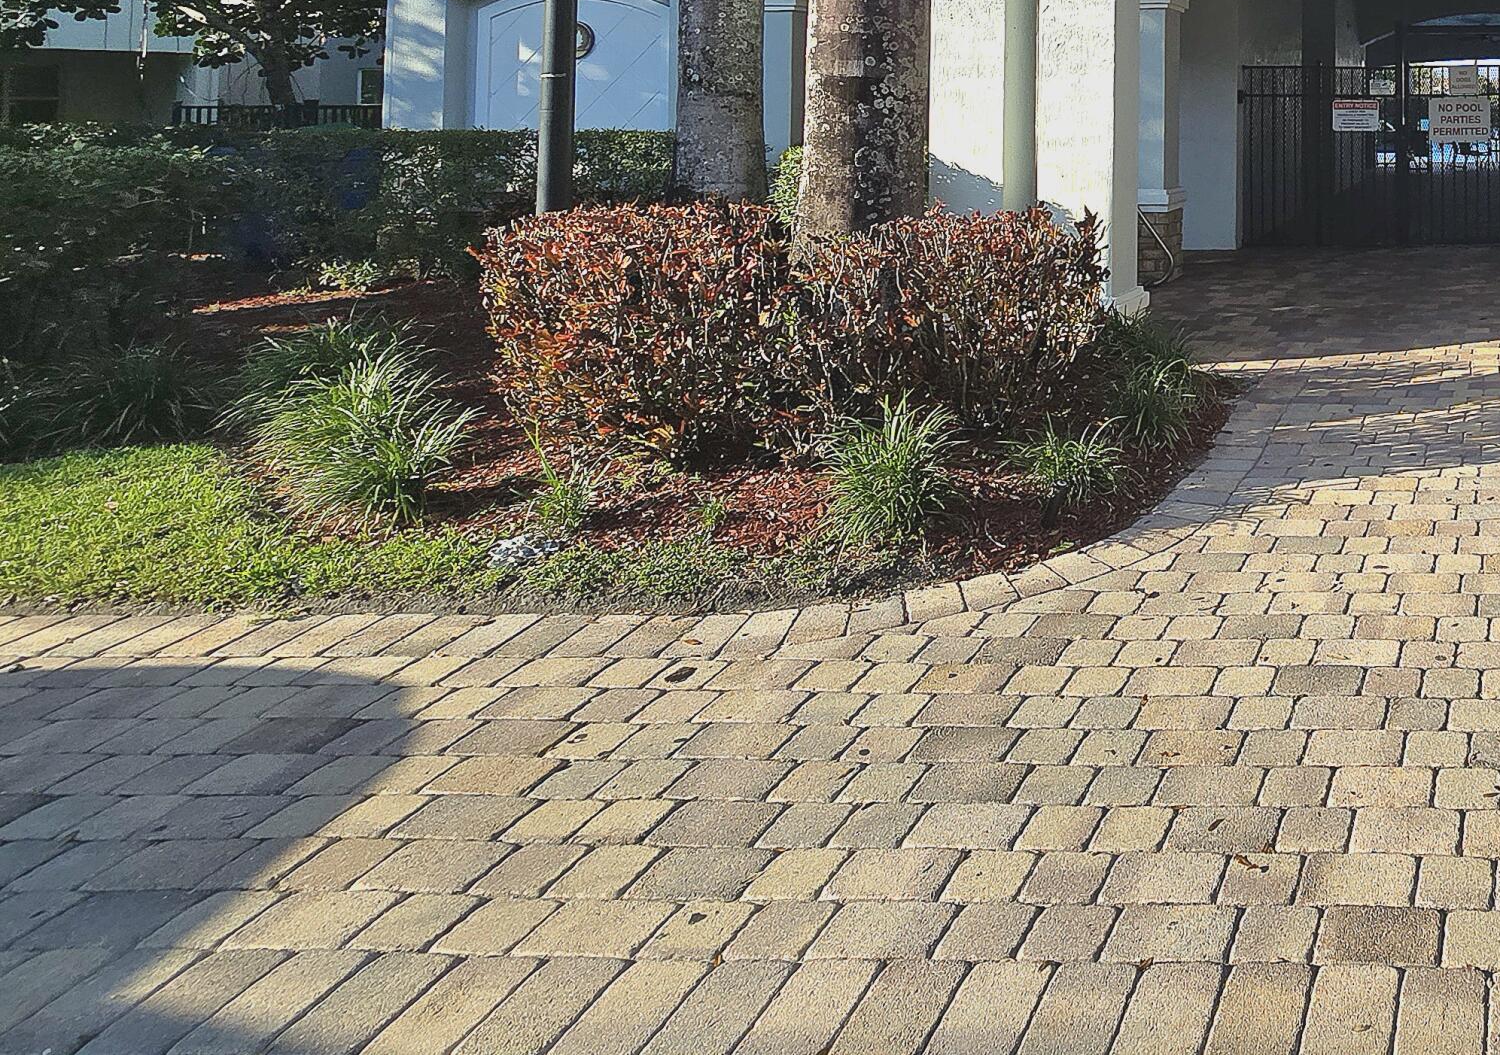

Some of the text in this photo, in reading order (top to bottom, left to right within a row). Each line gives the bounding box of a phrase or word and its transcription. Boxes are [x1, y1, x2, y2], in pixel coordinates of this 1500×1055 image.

[1438, 104, 1484, 112] NO POOL
[1440, 116, 1481, 124] PARTIES
